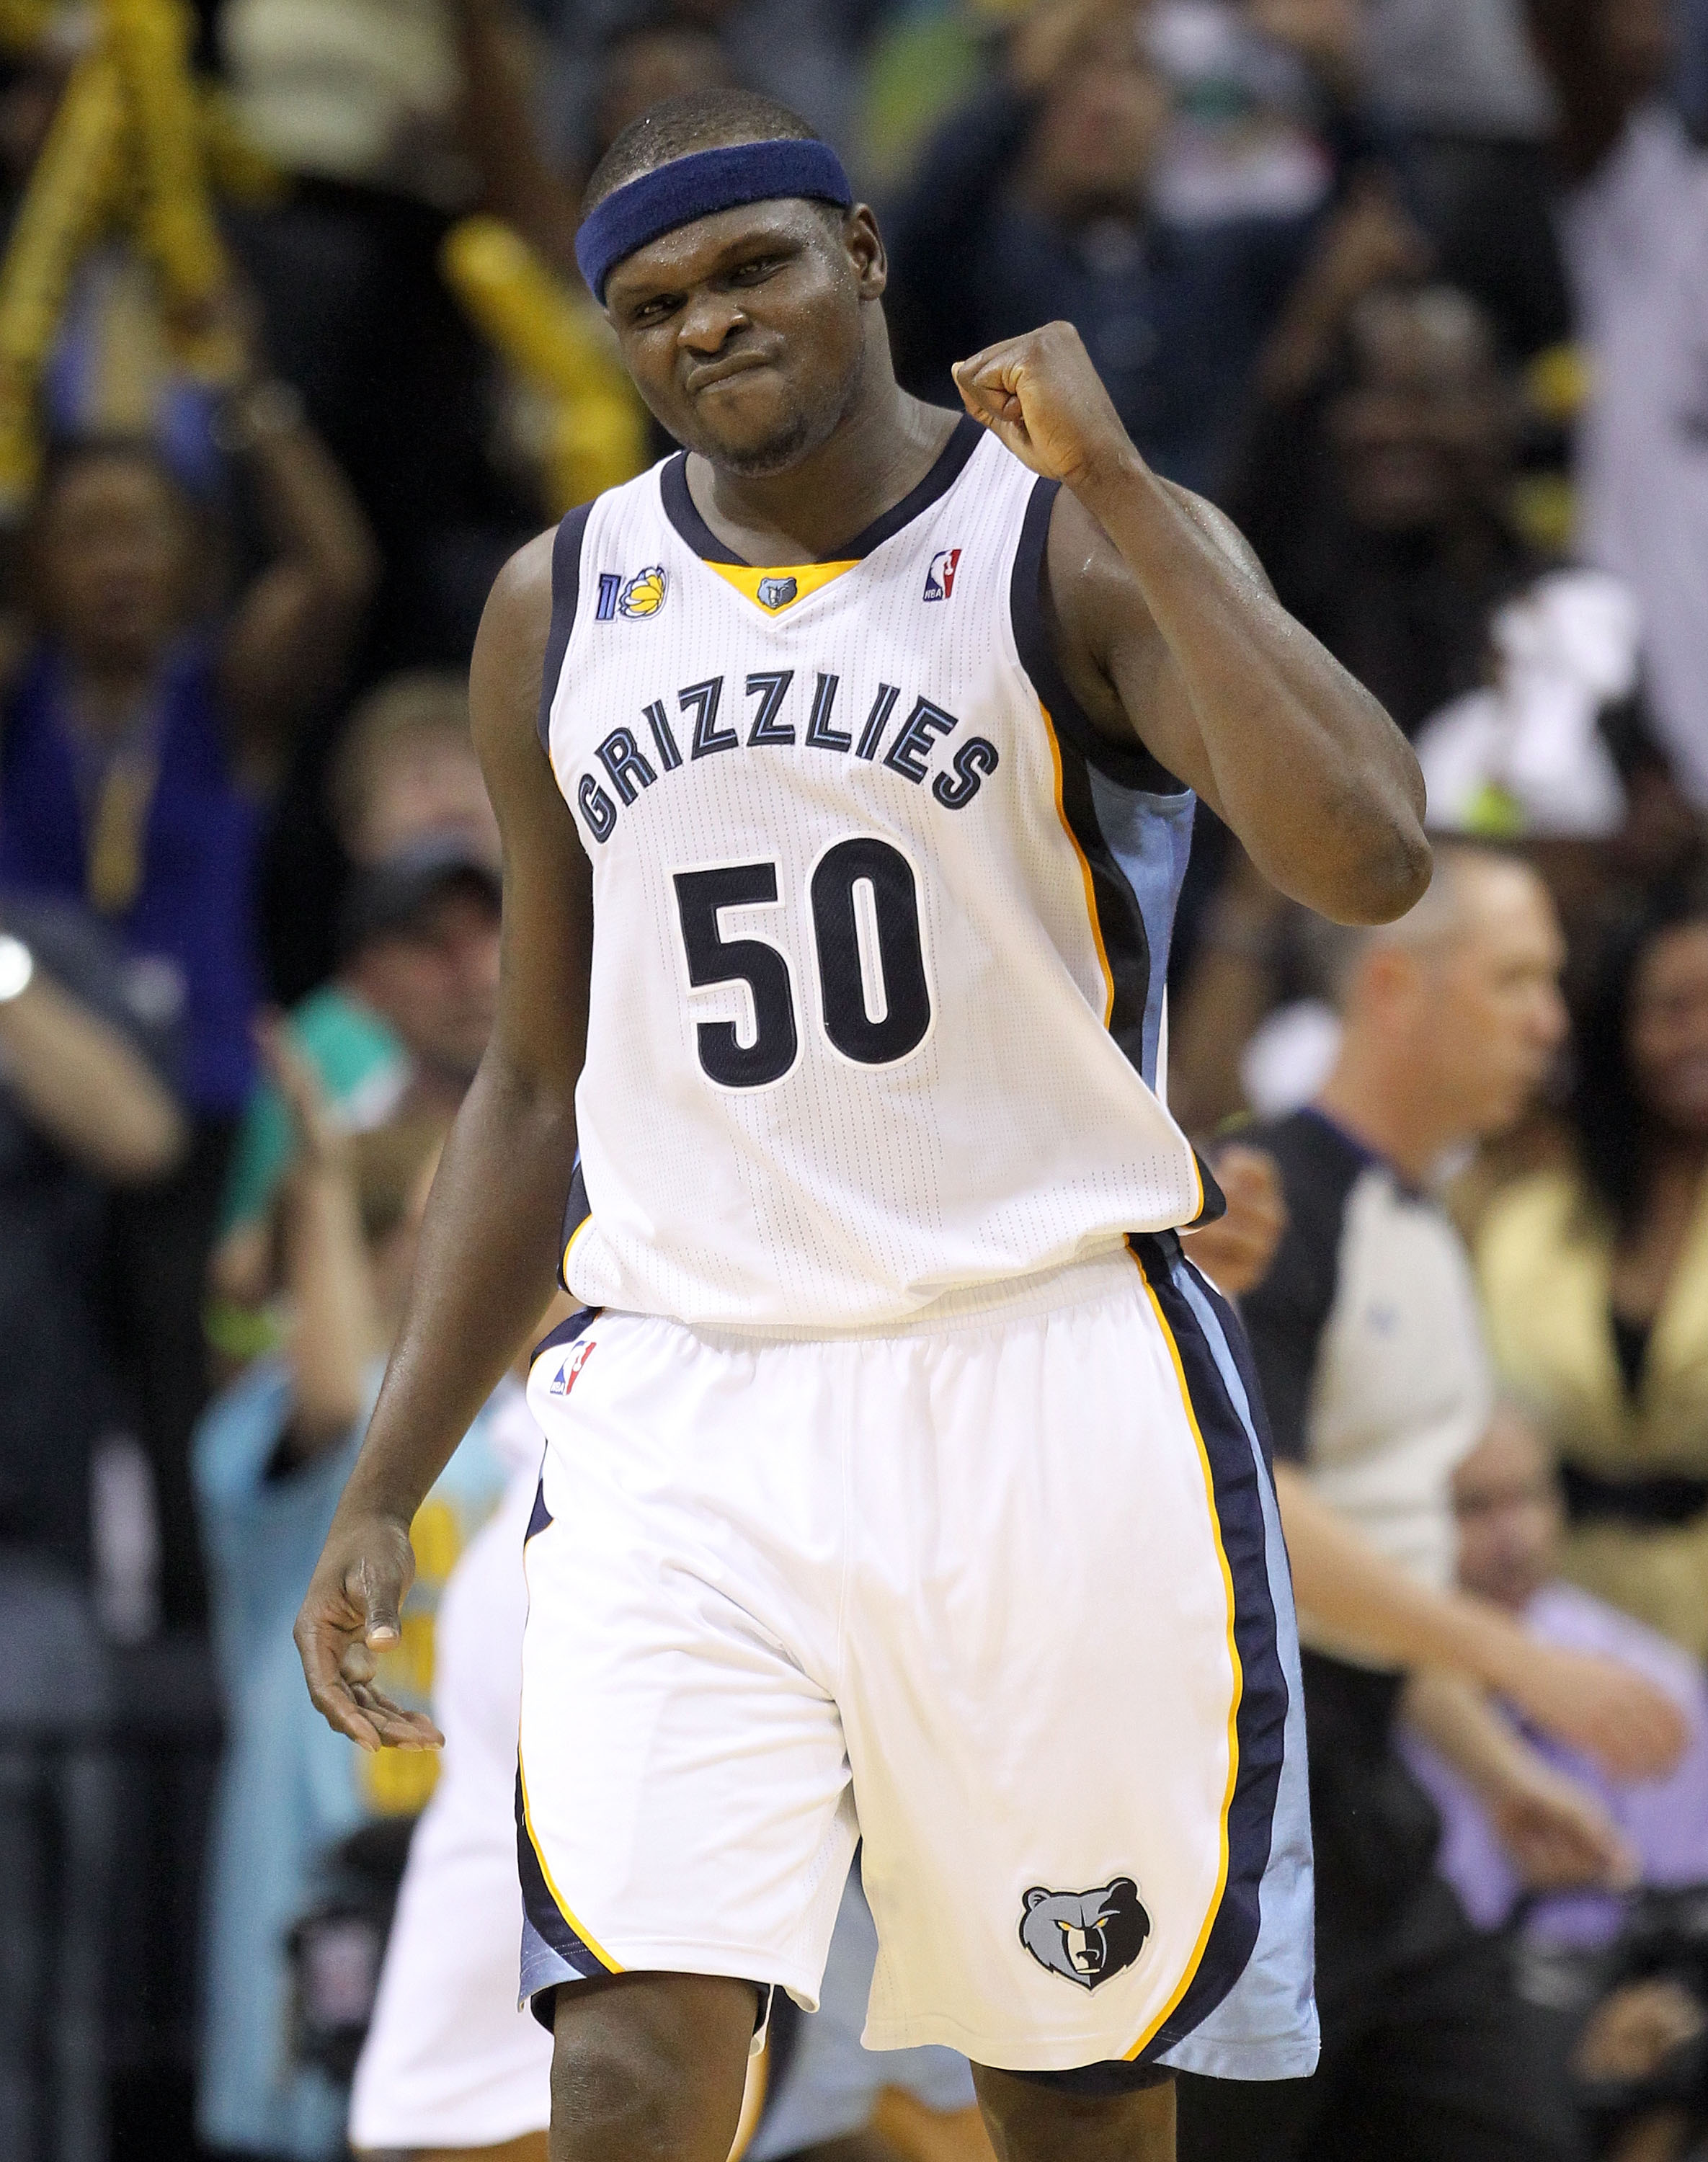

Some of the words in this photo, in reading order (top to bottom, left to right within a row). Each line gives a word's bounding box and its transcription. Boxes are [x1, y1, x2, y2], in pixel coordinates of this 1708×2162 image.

[924, 588, 942, 599] NBA
[578, 670, 999, 844] GRIZZLIES
[672, 837, 932, 1087] 50
